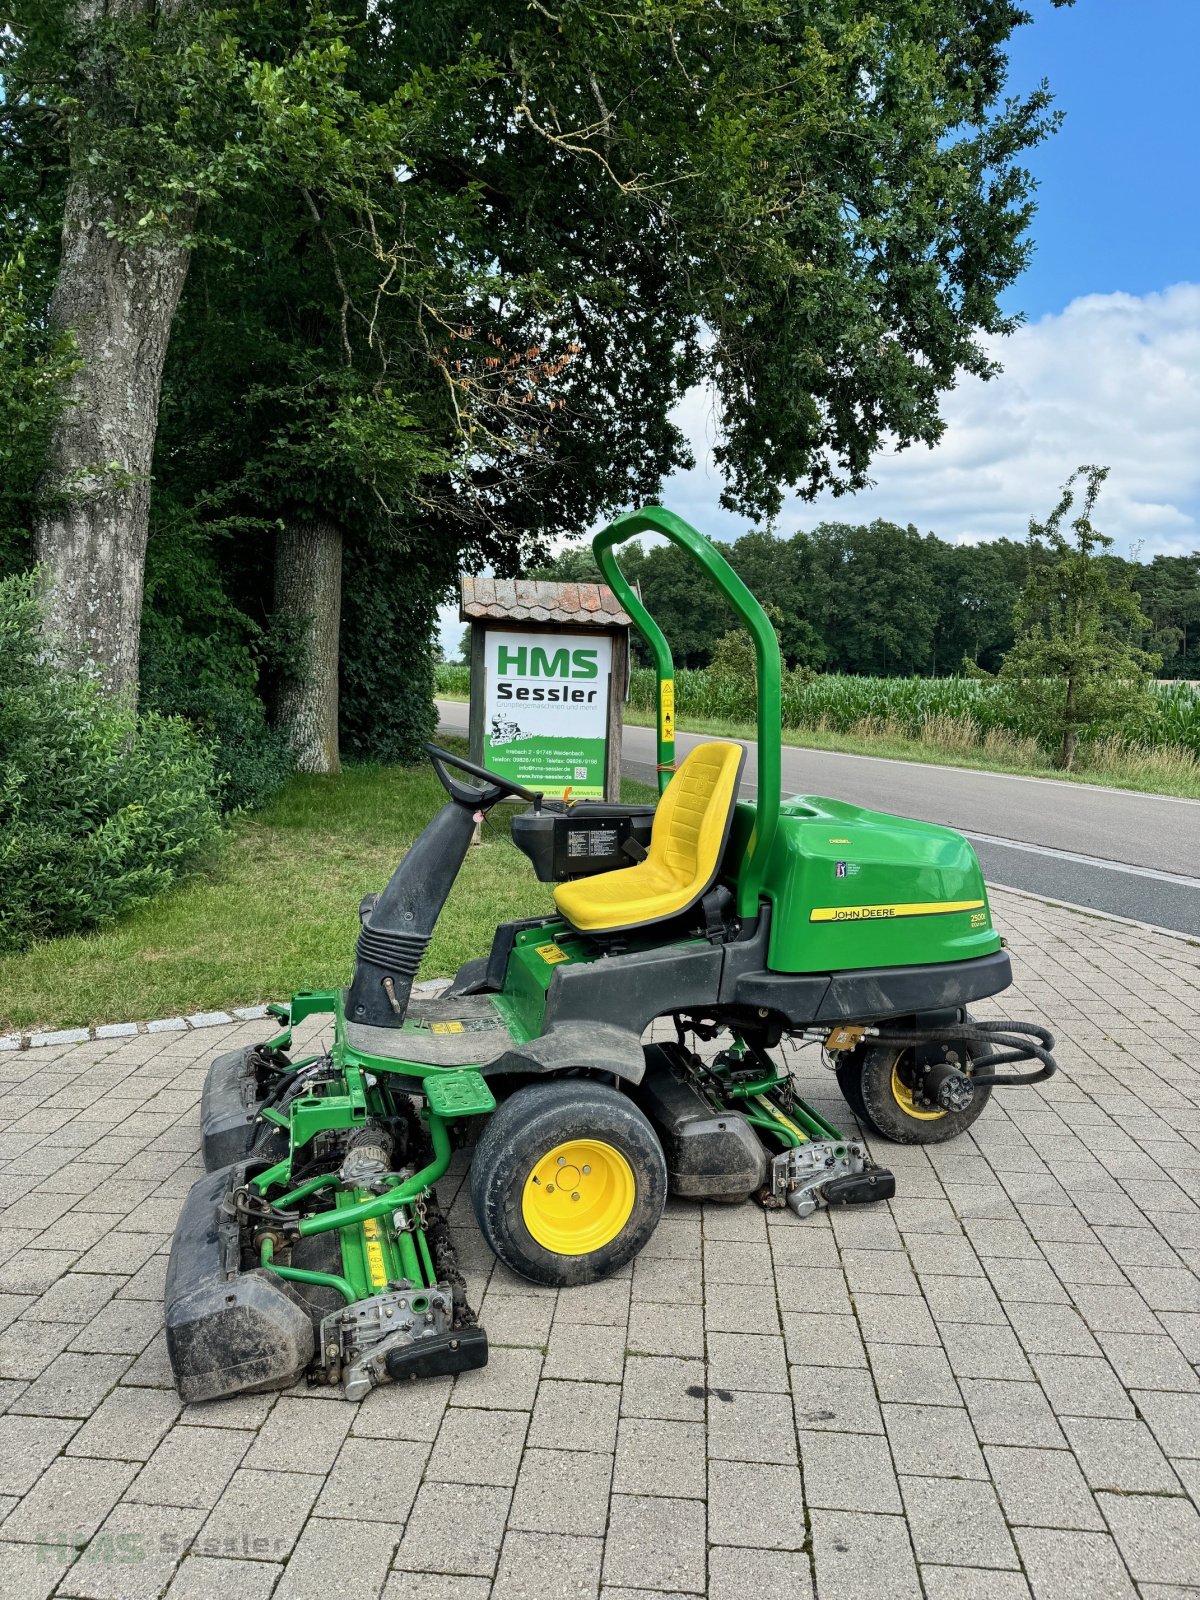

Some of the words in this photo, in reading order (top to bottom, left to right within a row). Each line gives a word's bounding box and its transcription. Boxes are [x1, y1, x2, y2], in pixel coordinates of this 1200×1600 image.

[497, 645, 598, 679] HMS
[497, 683, 597, 703] Sessler
[831, 910, 860, 919] JOHN
[862, 908, 895, 917] DEERE
